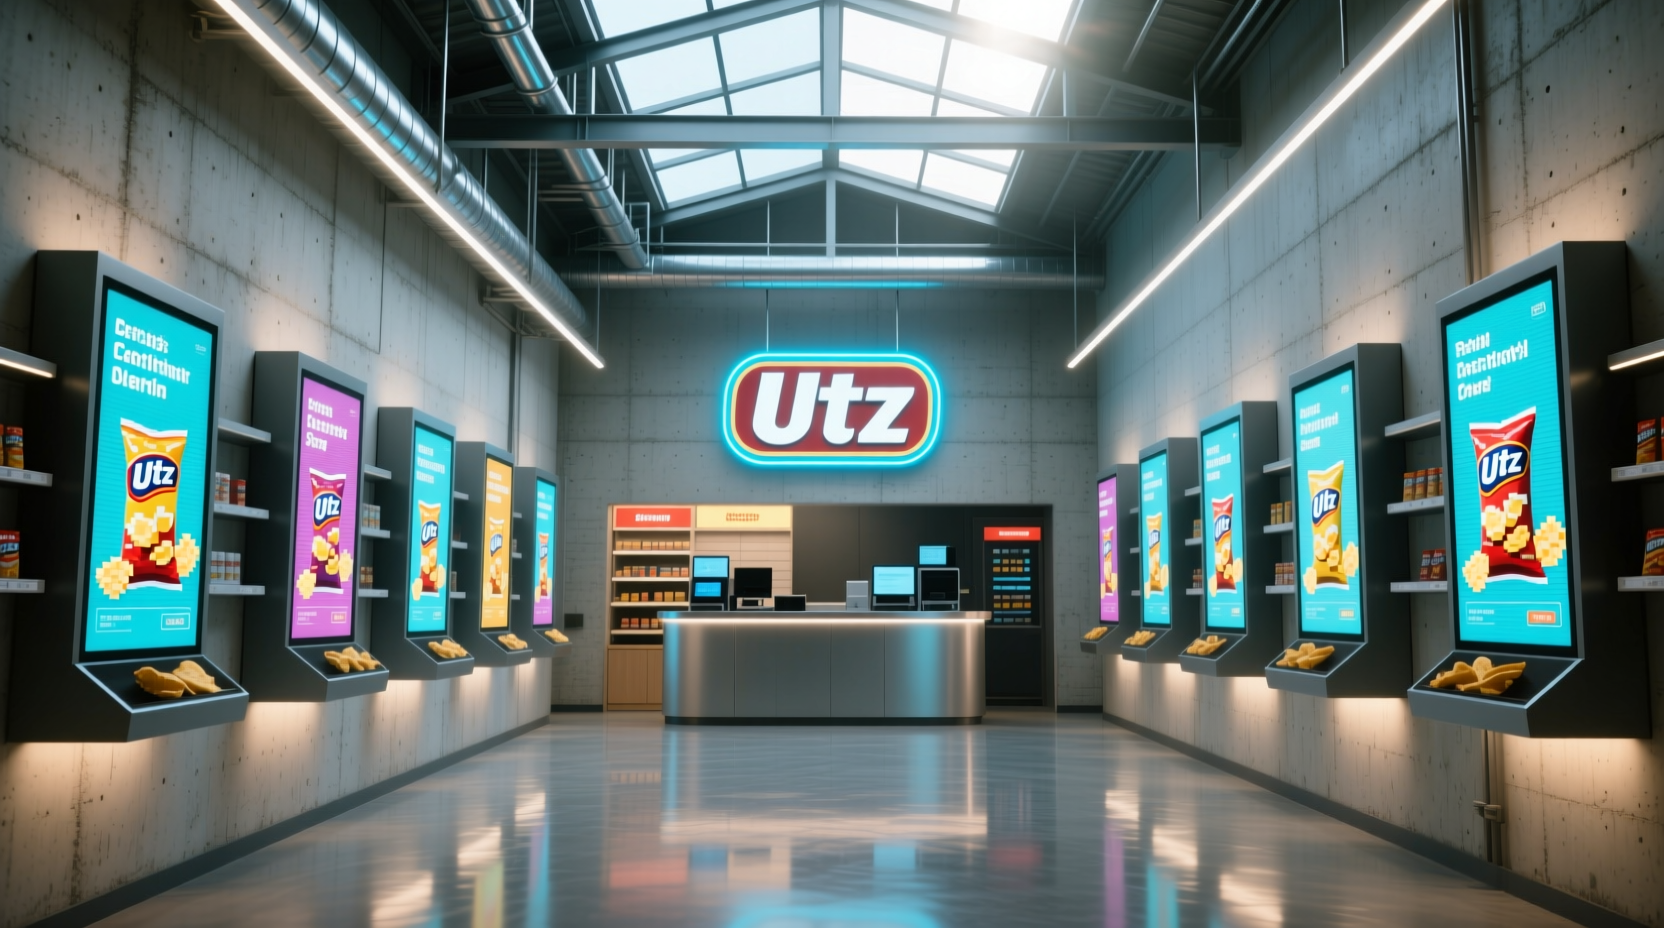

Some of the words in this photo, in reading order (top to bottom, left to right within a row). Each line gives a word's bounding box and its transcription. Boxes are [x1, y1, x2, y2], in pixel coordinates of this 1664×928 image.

[752, 372, 915, 446] Utz
[132, 460, 176, 490] Utz
[1481, 449, 1523, 485] Utz
